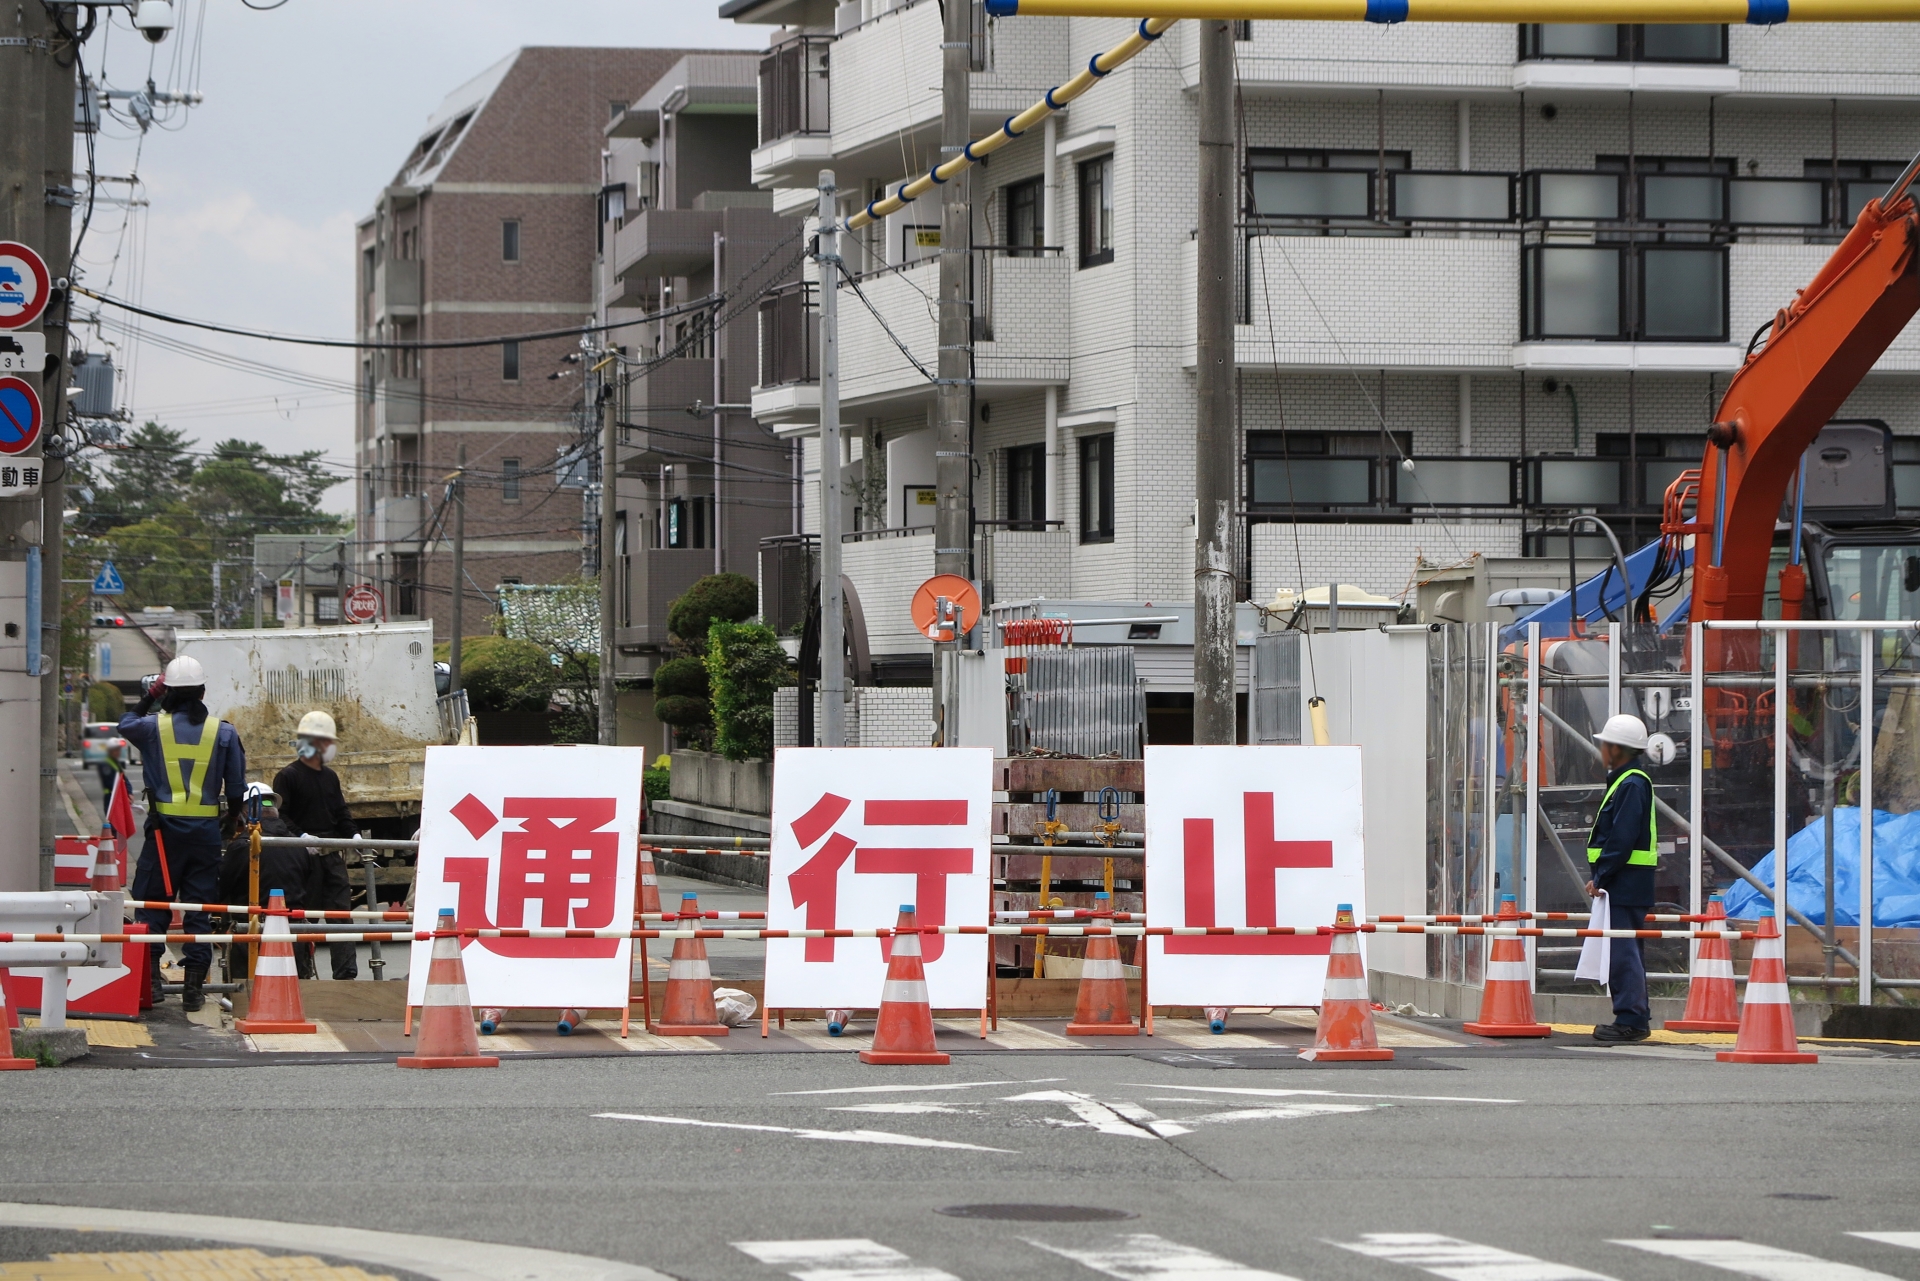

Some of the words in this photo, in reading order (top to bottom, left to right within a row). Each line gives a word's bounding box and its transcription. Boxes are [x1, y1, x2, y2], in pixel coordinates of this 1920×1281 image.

[2, 466, 39, 487] 動車
[443, 793, 619, 959] 通
[788, 792, 974, 963] 行
[1163, 791, 1337, 956] 止
